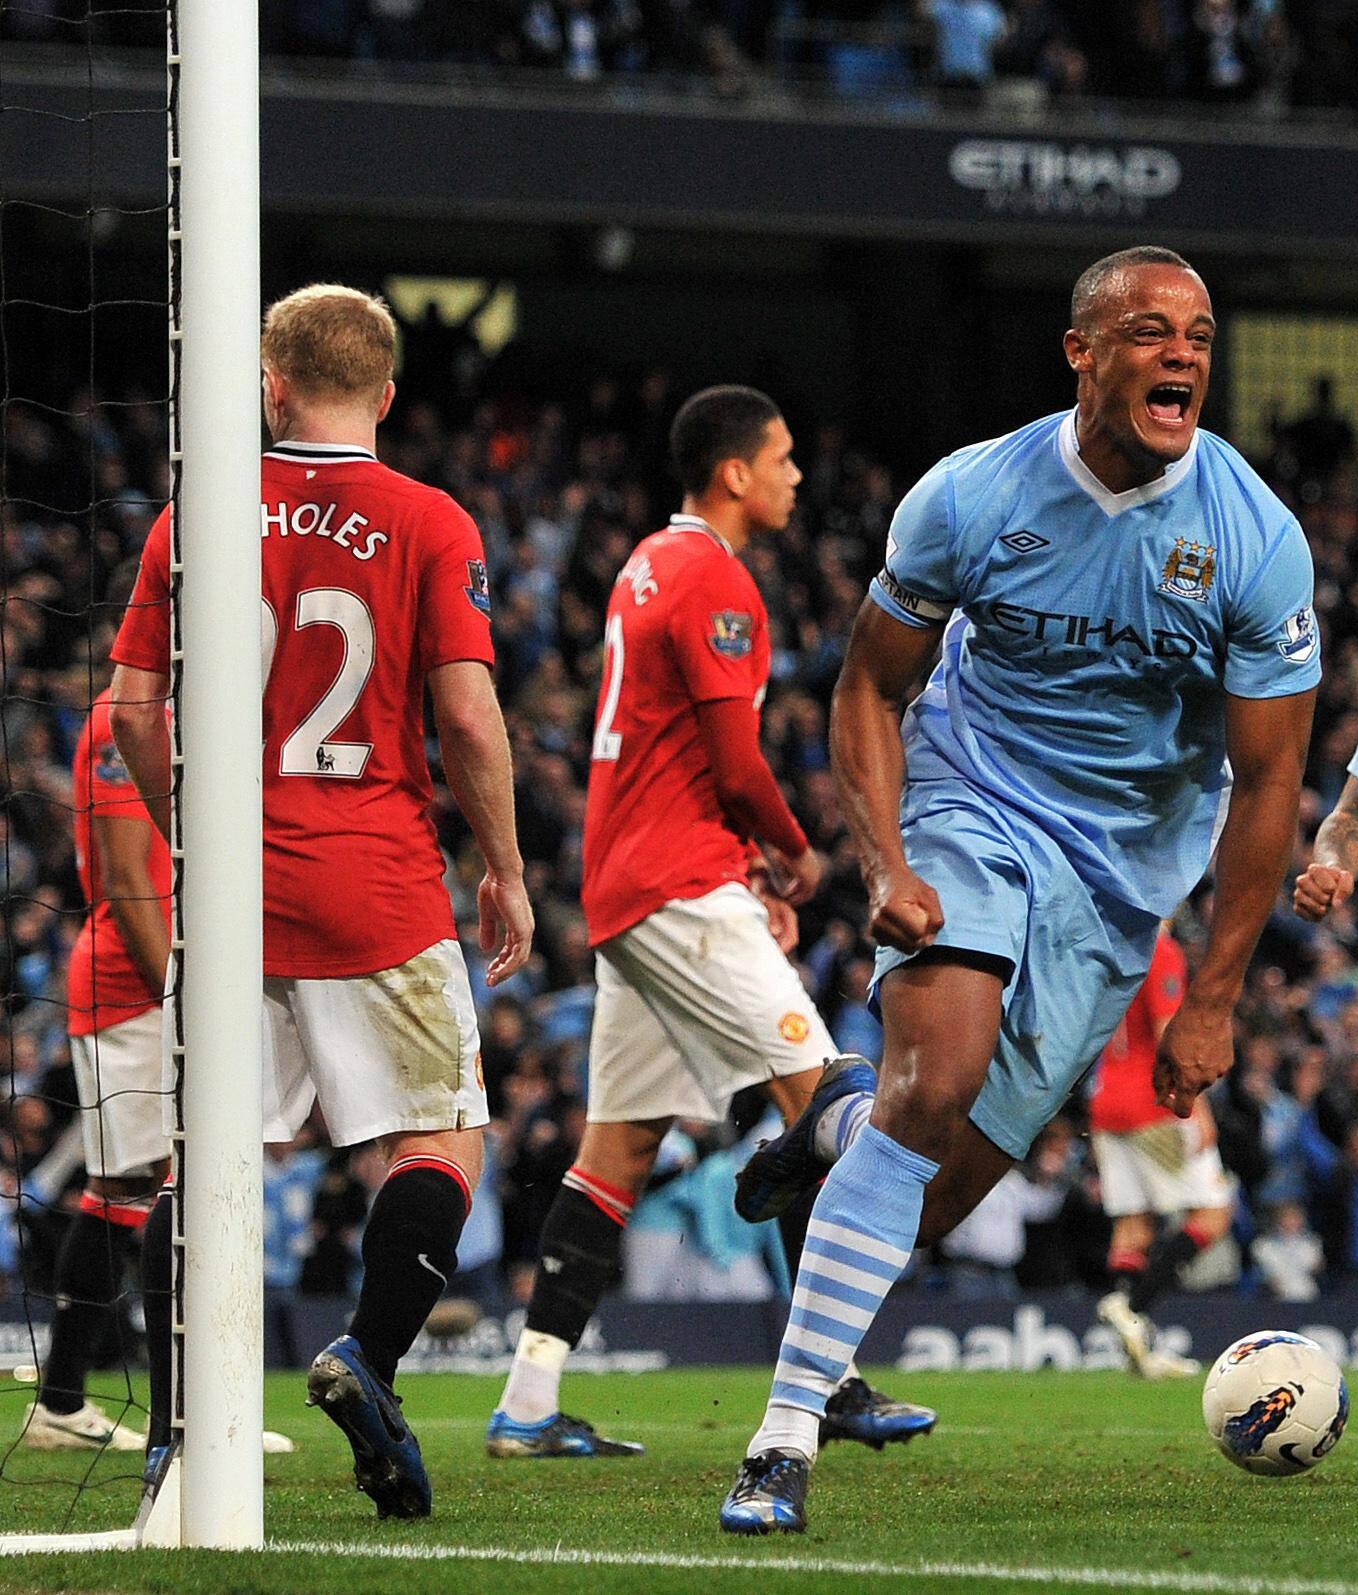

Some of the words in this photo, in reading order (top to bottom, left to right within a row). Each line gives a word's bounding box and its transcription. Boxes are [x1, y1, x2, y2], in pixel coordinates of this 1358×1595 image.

[261, 502, 389, 561] HOLES
[882, 576, 921, 610] TAIN
[990, 602, 1199, 660] ETIHAD
